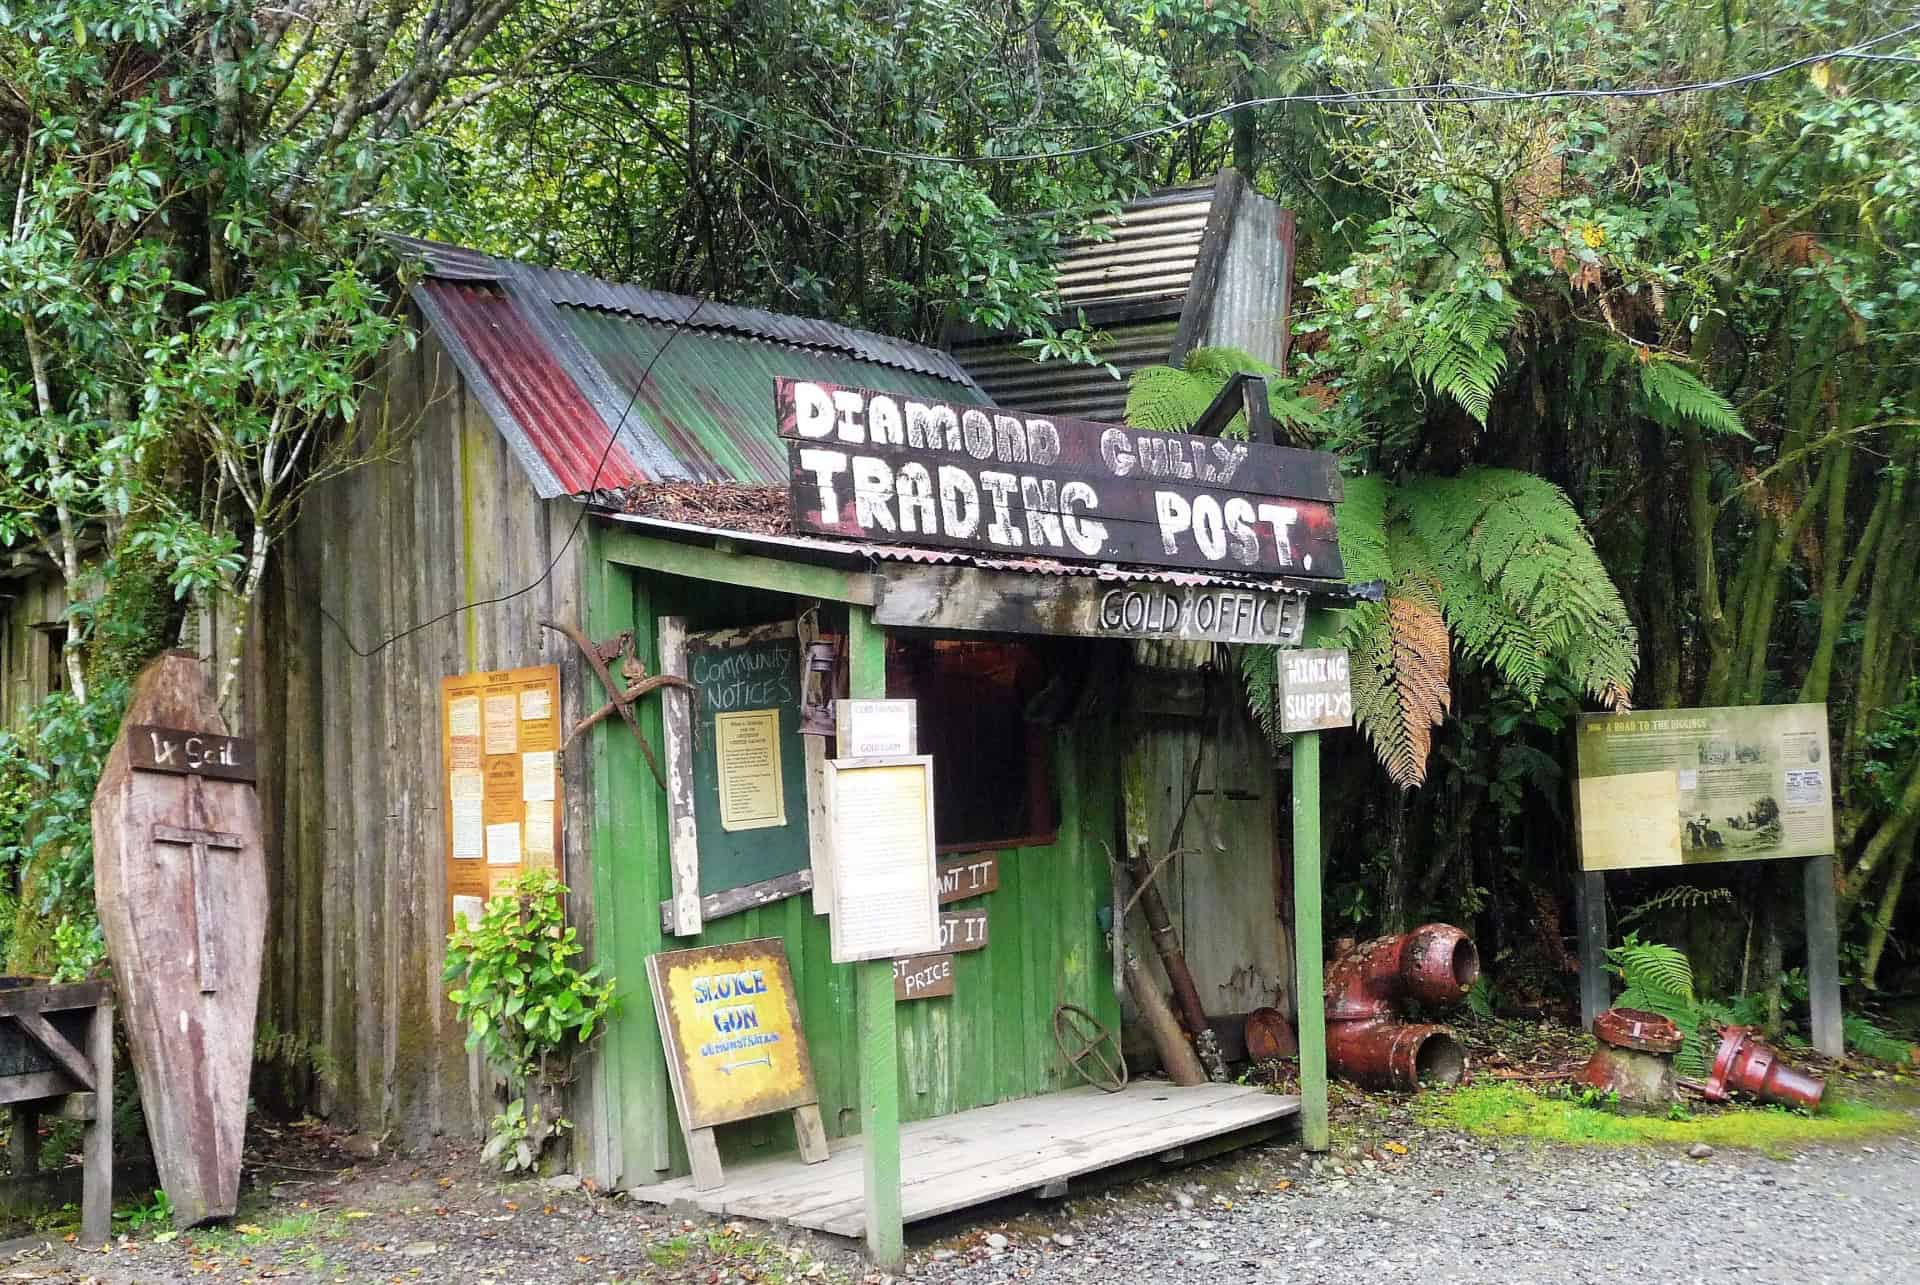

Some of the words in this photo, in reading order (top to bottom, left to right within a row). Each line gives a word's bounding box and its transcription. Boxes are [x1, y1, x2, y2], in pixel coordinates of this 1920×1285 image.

[794, 382, 1060, 465] DIAMOND
[1101, 428, 1248, 483] GULLY
[800, 449, 1108, 556] TRADING
[1101, 588, 1179, 633] GOLD
[1195, 592, 1297, 638] OFFICE
[1286, 655, 1347, 684] MINING
[707, 673, 793, 709] NOTICES
[936, 867, 964, 896] ANT
[967, 860, 993, 889] IT
[939, 919, 959, 947] OT
[964, 917, 987, 942] IT
[693, 970, 768, 1004] SLUICE
[904, 961, 951, 997] PRICE
[712, 1005, 759, 1034] GUN
